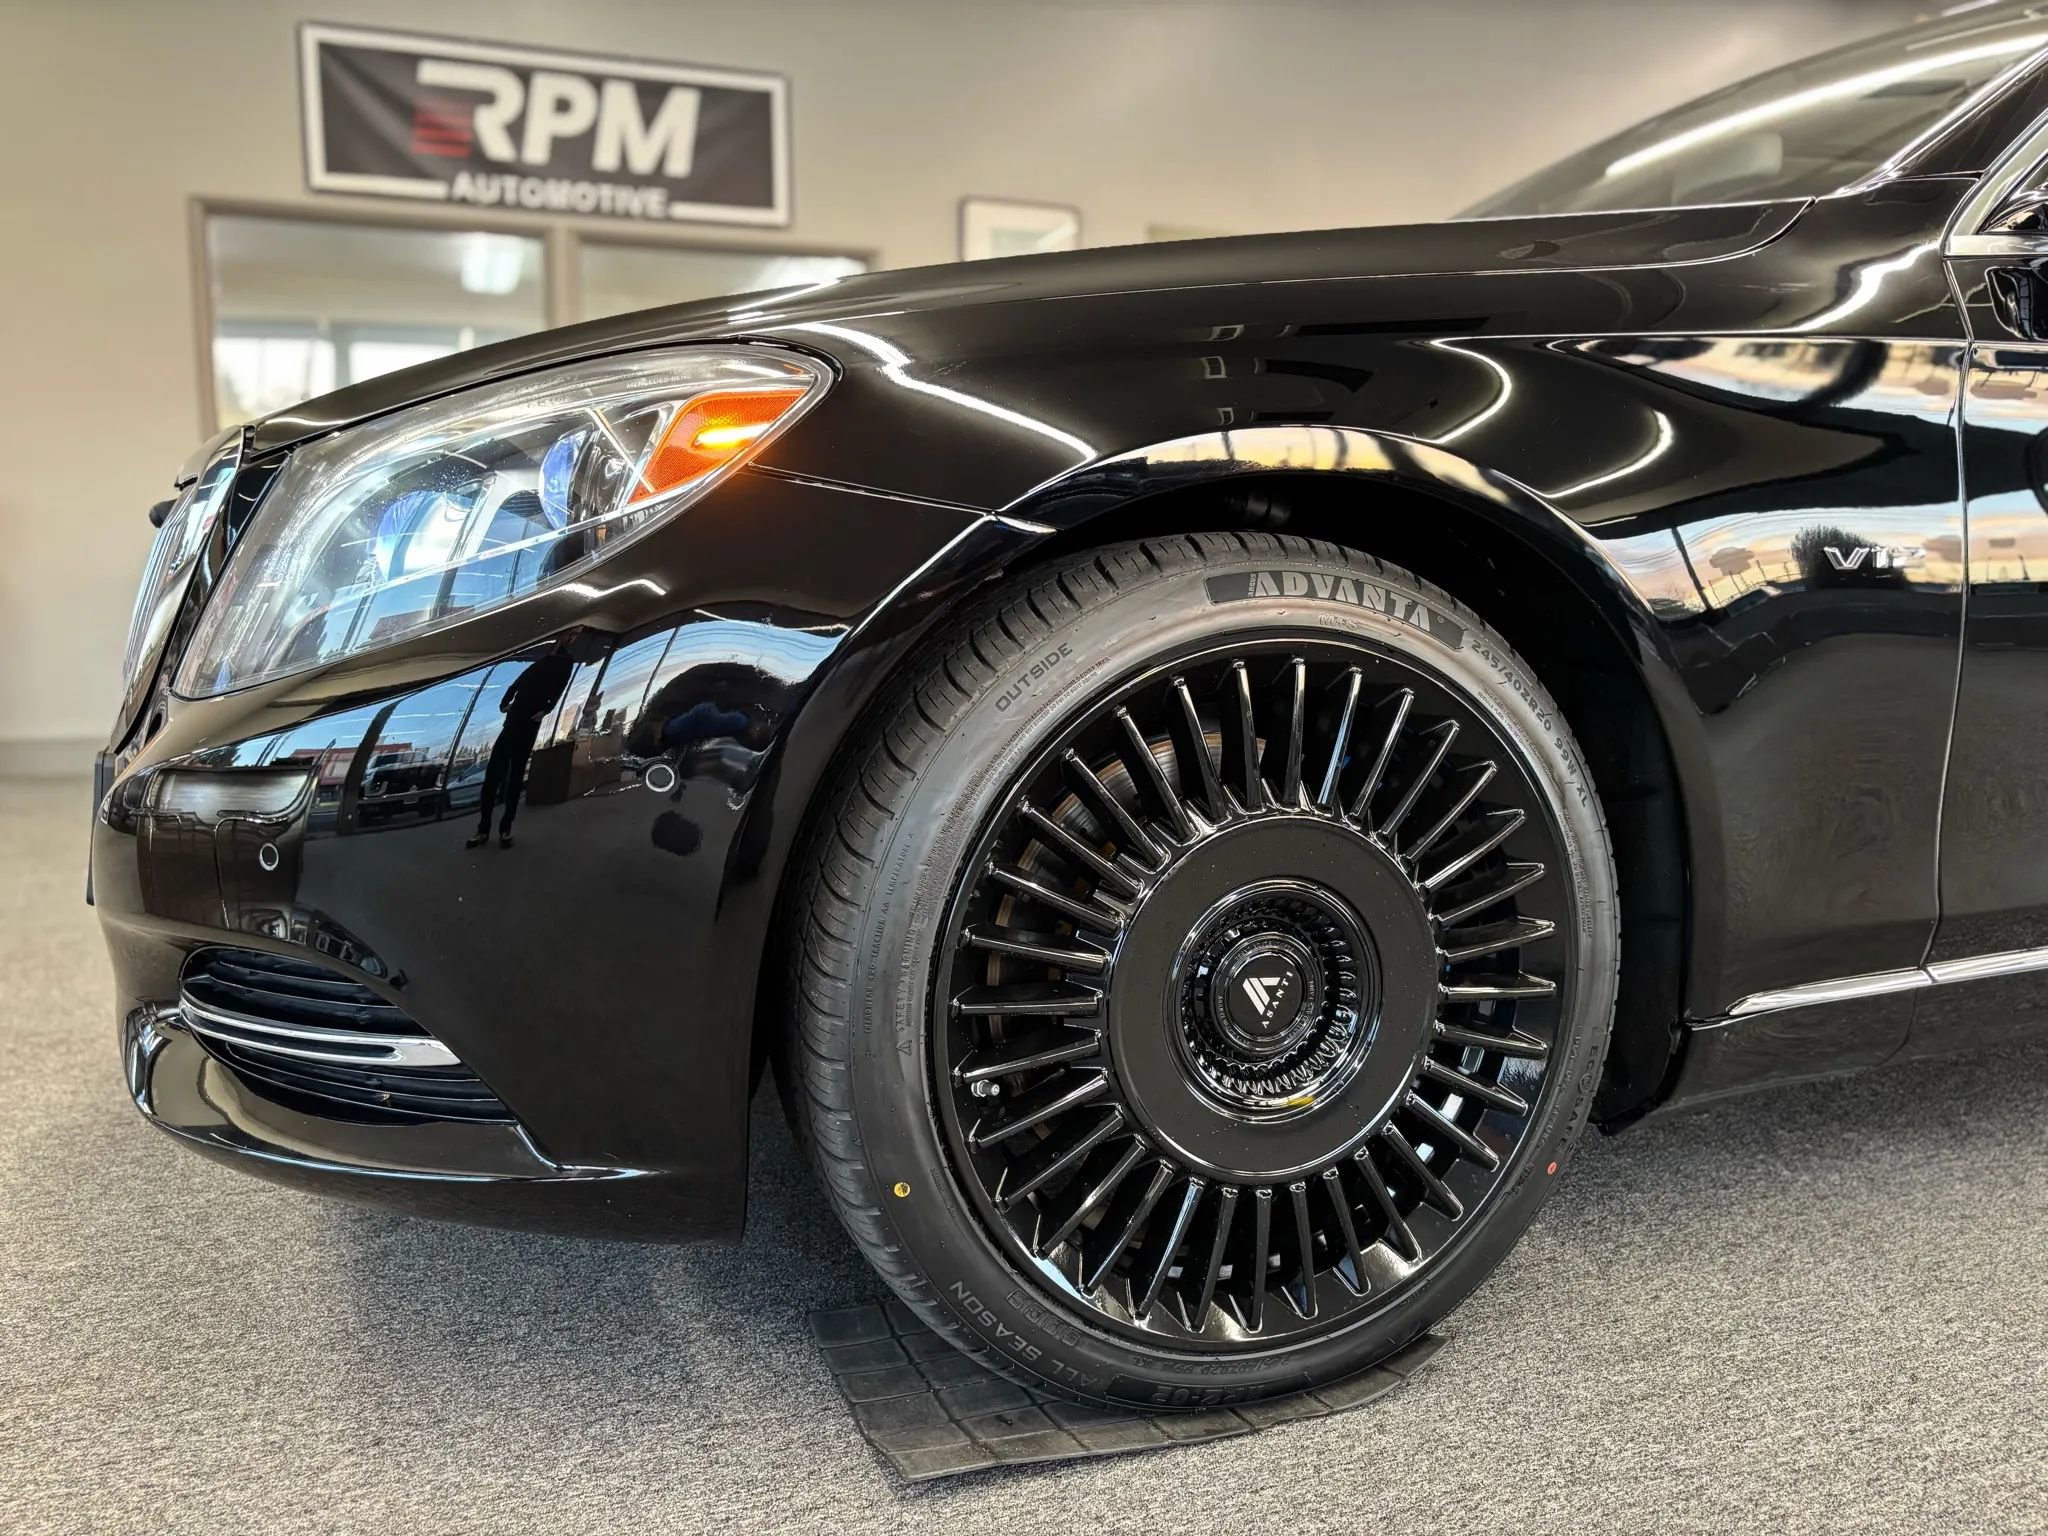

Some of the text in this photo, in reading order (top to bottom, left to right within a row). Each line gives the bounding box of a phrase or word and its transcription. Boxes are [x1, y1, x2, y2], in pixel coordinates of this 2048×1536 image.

[413, 59, 702, 178] RPM
[451, 171, 668, 219] AUTOMOTIVE
[1823, 546, 1927, 570] V12
[1255, 571, 1431, 632] ADVANTA
[994, 642, 1074, 713] OUTSIDE
[1472, 639, 1553, 733] 245/40ZR20
[1554, 737, 1577, 778] 99W
[1574, 785, 1590, 808] XL
[1261, 971, 1294, 1029] ASANTI
[949, 1280, 1044, 1361] SEASON
[1051, 1359, 1098, 1387] ALL
